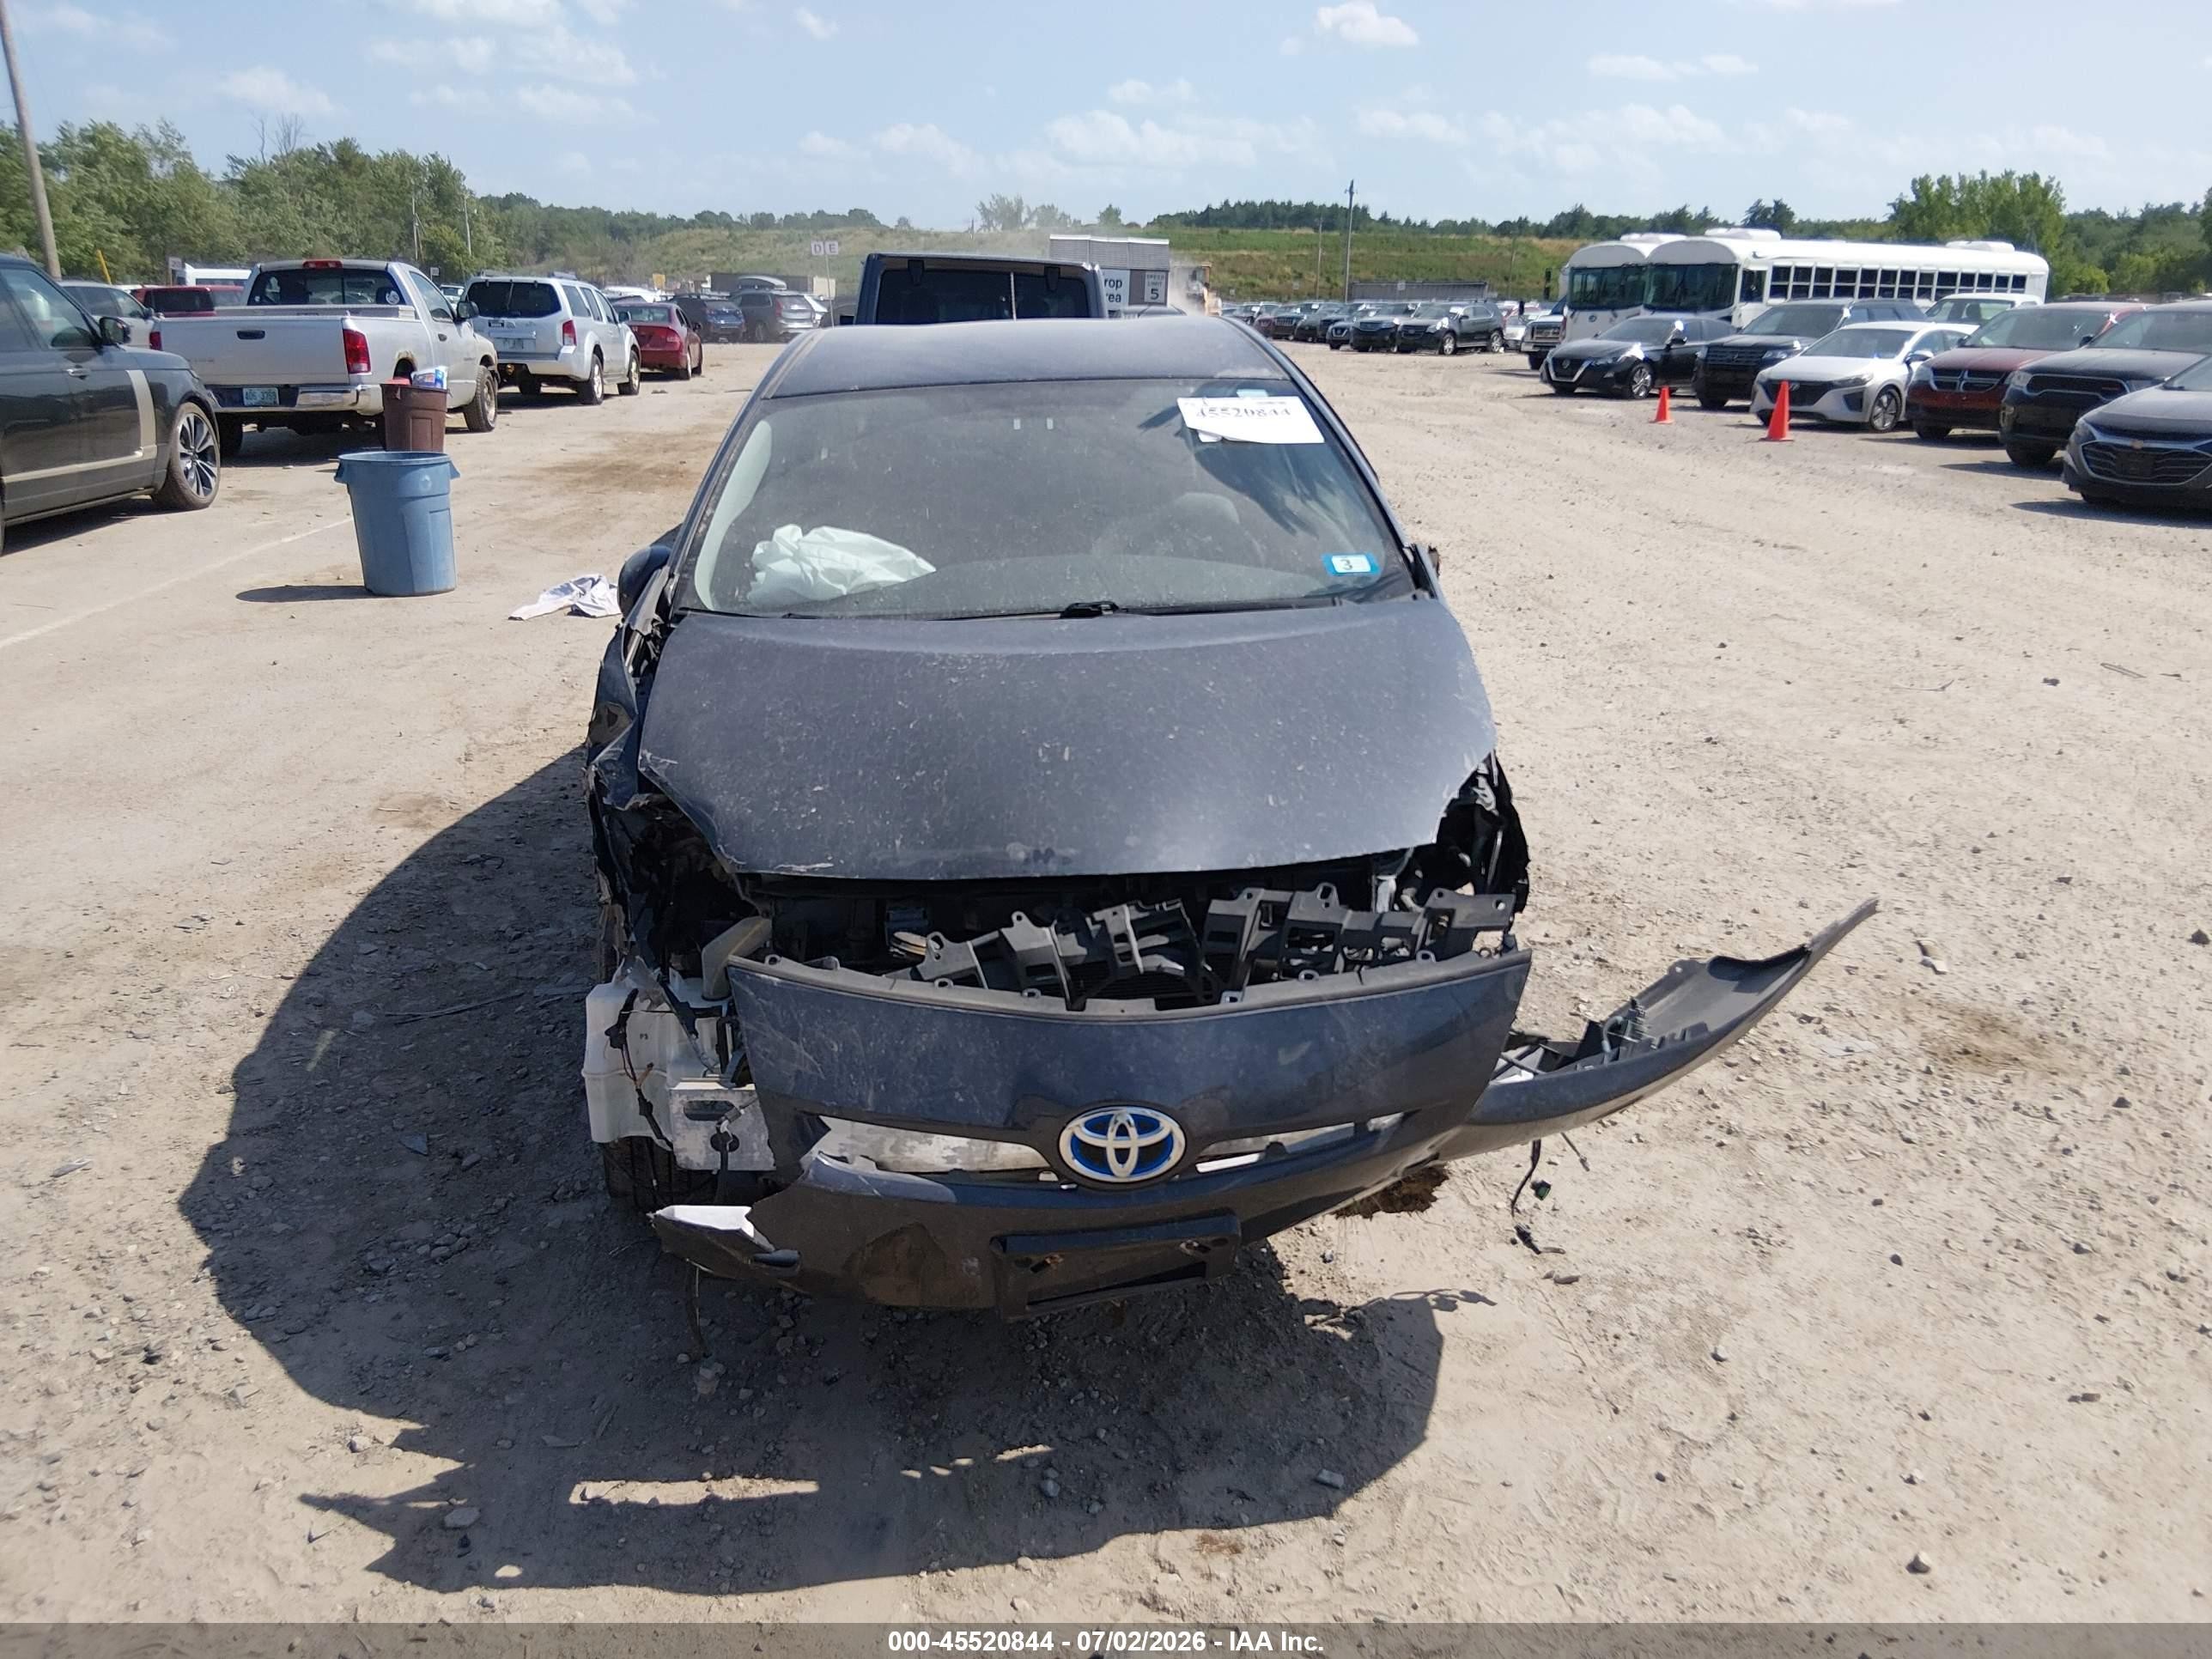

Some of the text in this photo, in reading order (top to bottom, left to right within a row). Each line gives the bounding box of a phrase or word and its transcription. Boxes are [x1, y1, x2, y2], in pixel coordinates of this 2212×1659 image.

[829, 244, 837, 253] E
[1151, 289, 1159, 300] 5
[1340, 559, 1352, 570] 3
